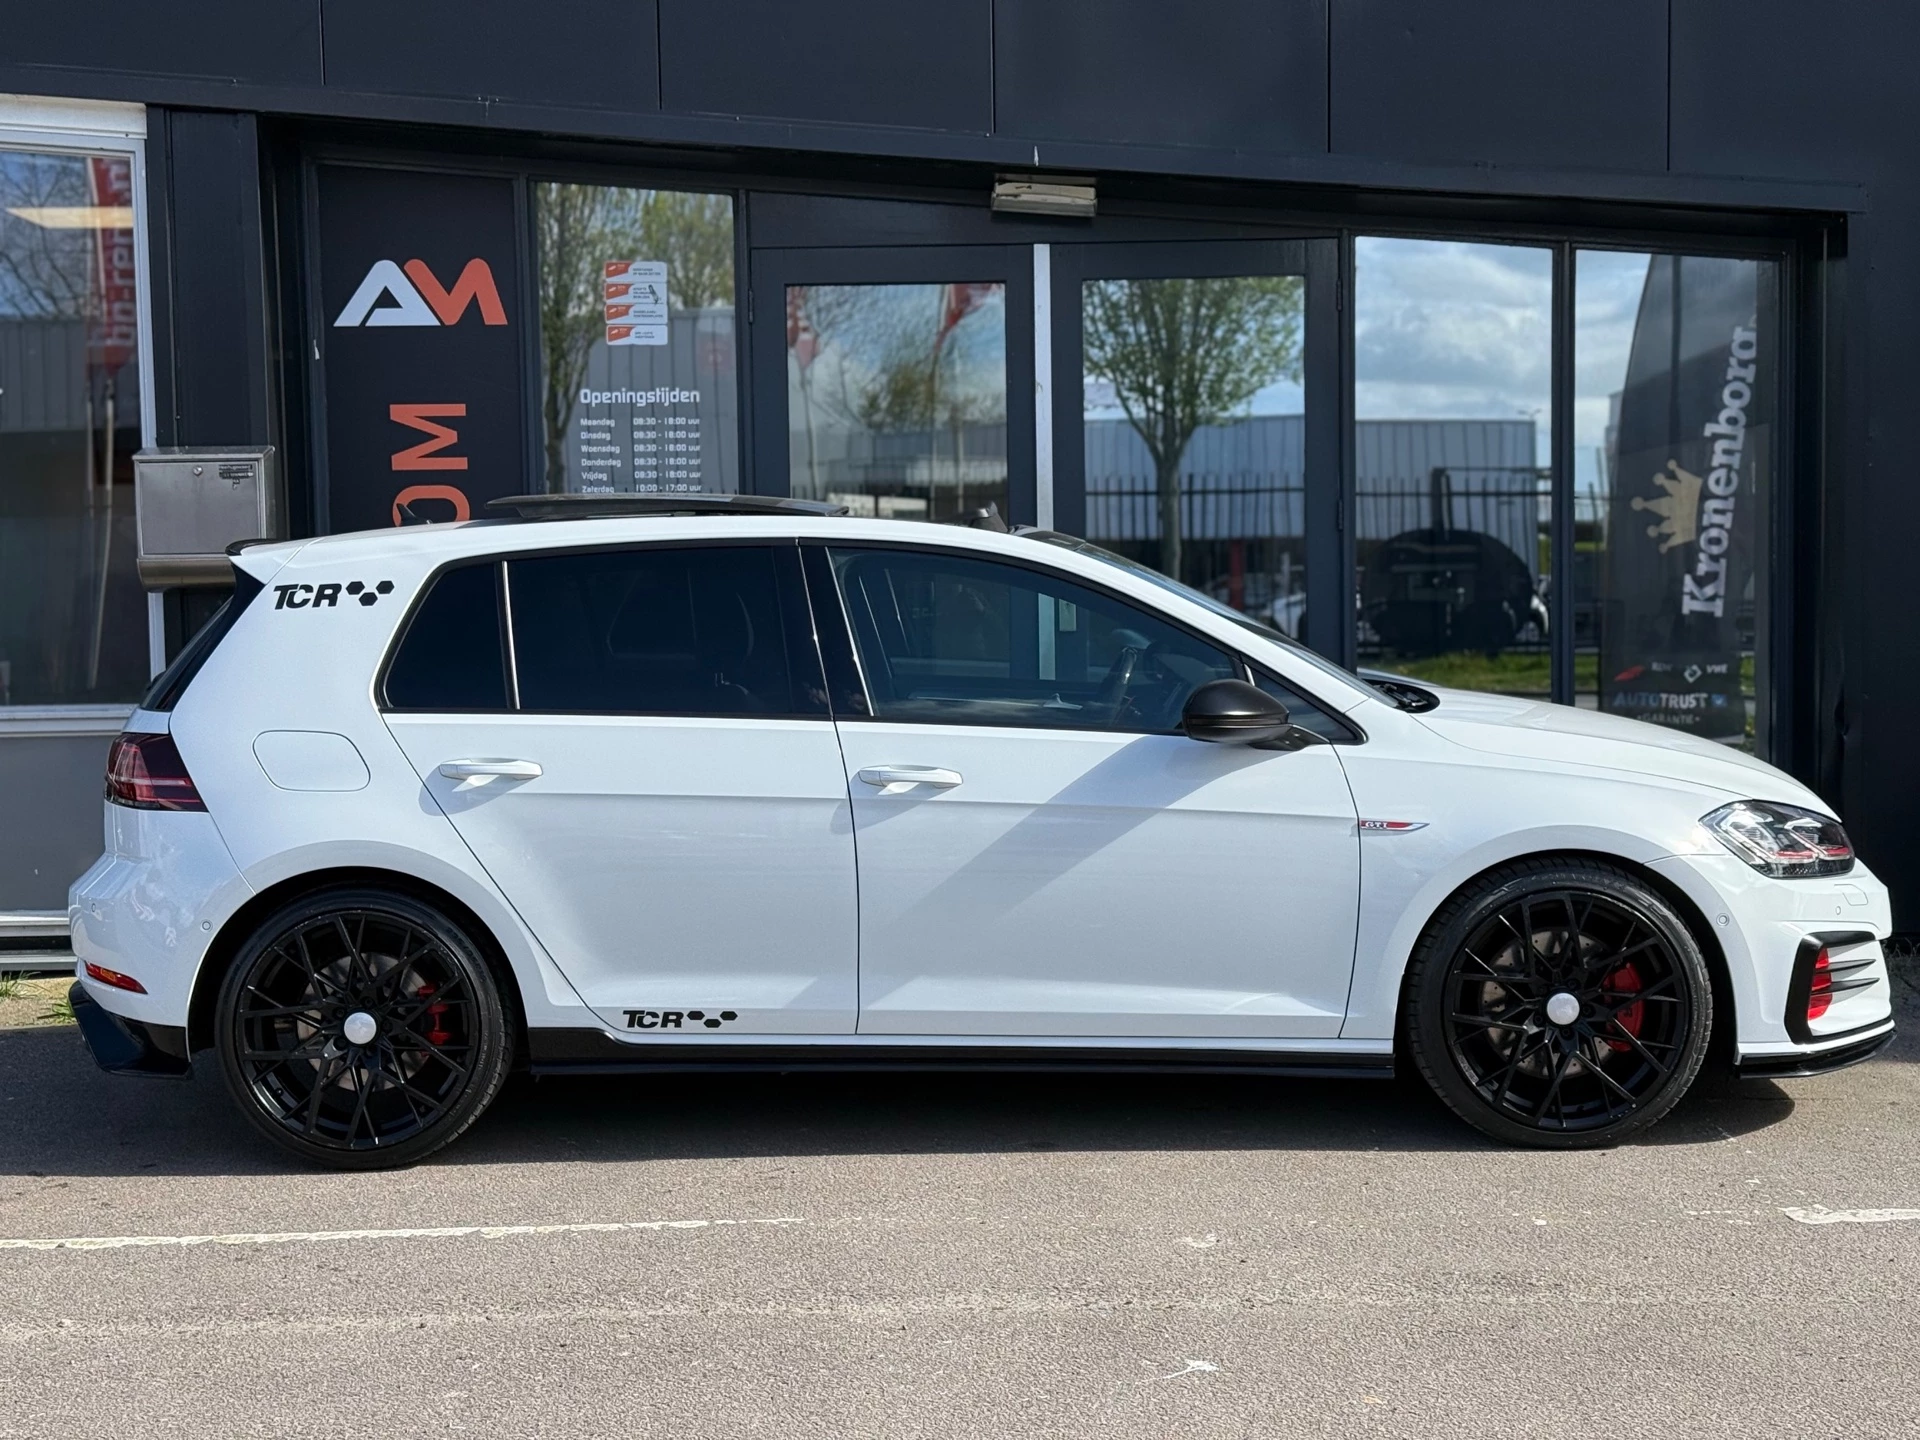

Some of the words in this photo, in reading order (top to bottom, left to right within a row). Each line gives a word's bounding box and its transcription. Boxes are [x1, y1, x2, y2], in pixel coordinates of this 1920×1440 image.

[333, 258, 508, 327] AM
[580, 387, 700, 407] Openingstijden
[580, 418, 616, 427] Maandag
[580, 431, 611, 441] Dinsdag
[633, 431, 656, 439] 08:30
[665, 431, 686, 439] 18:00
[581, 445, 620, 454] Woensdag
[634, 444, 656, 452] 08:30
[665, 444, 686, 452] 18:00
[581, 458, 621, 467] Donderdag
[634, 457, 657, 465] 08:30
[665, 457, 687, 465] 18:00
[581, 472, 608, 481] Vrijdag
[636, 484, 657, 492] 10:00
[666, 484, 687, 492] 17:00
[273, 583, 342, 610] TCR
[1613, 691, 1708, 709] AUTOTRUST
[1365, 821, 1388, 829] GTI
[622, 1010, 684, 1029] TCR
